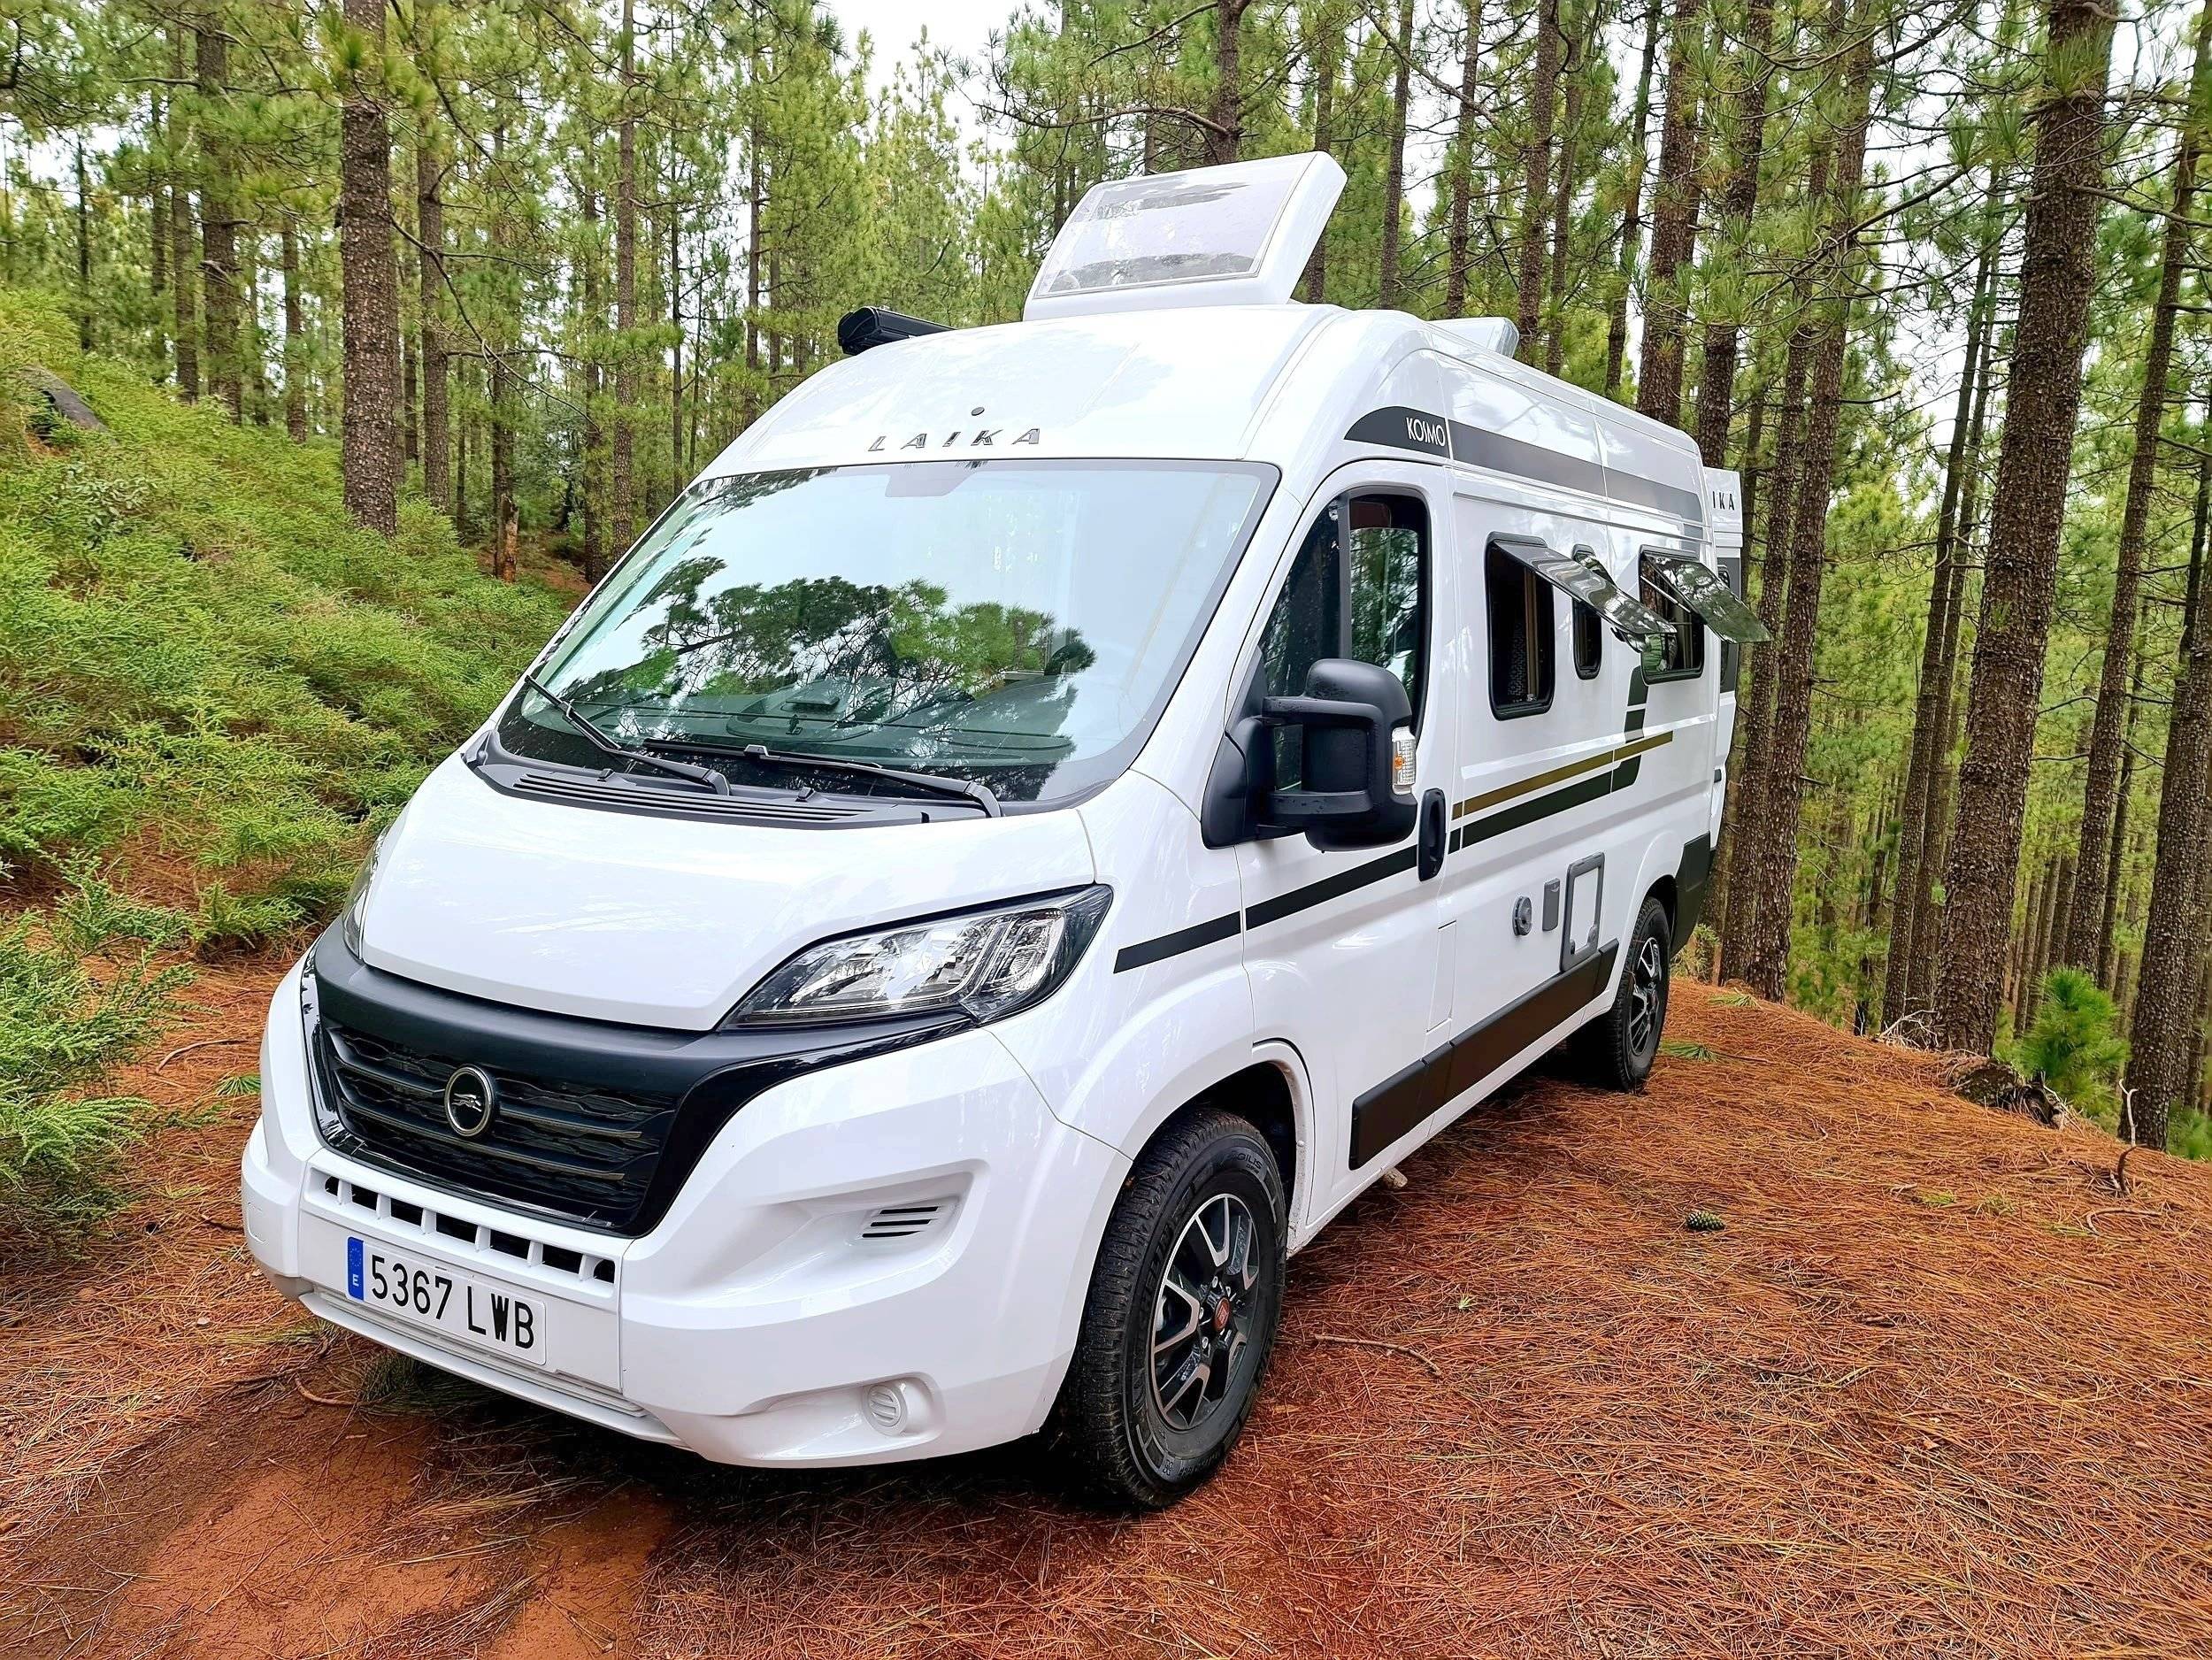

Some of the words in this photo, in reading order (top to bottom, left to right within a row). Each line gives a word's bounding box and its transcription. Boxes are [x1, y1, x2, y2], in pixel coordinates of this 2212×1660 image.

[868, 427, 1041, 452] LAIKA
[352, 1274, 359, 1287] E
[372, 1254, 453, 1319] 5367
[467, 1285, 534, 1349] LWB
